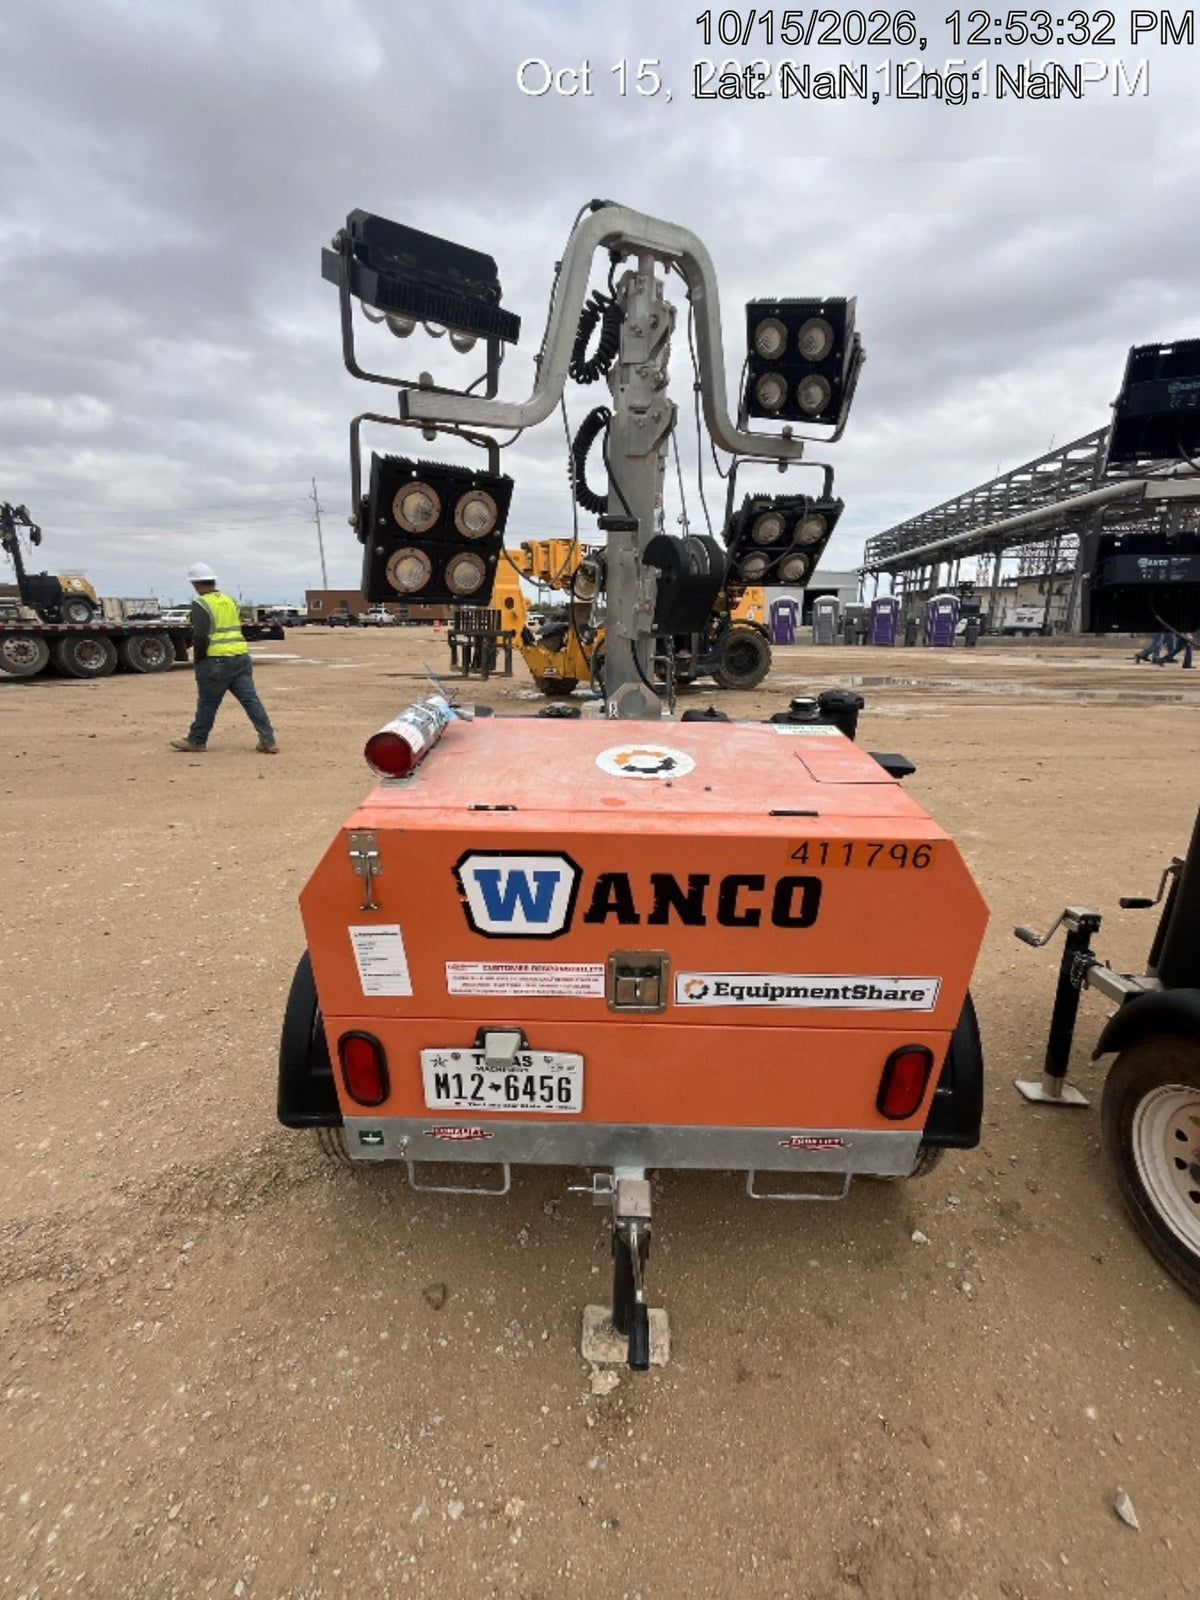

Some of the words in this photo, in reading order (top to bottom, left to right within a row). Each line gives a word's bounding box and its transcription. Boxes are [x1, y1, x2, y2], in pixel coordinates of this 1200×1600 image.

[790, 841, 932, 869] 411796
[713, 982, 926, 1001] EquipmentShare
[471, 1054, 533, 1068] TAS
